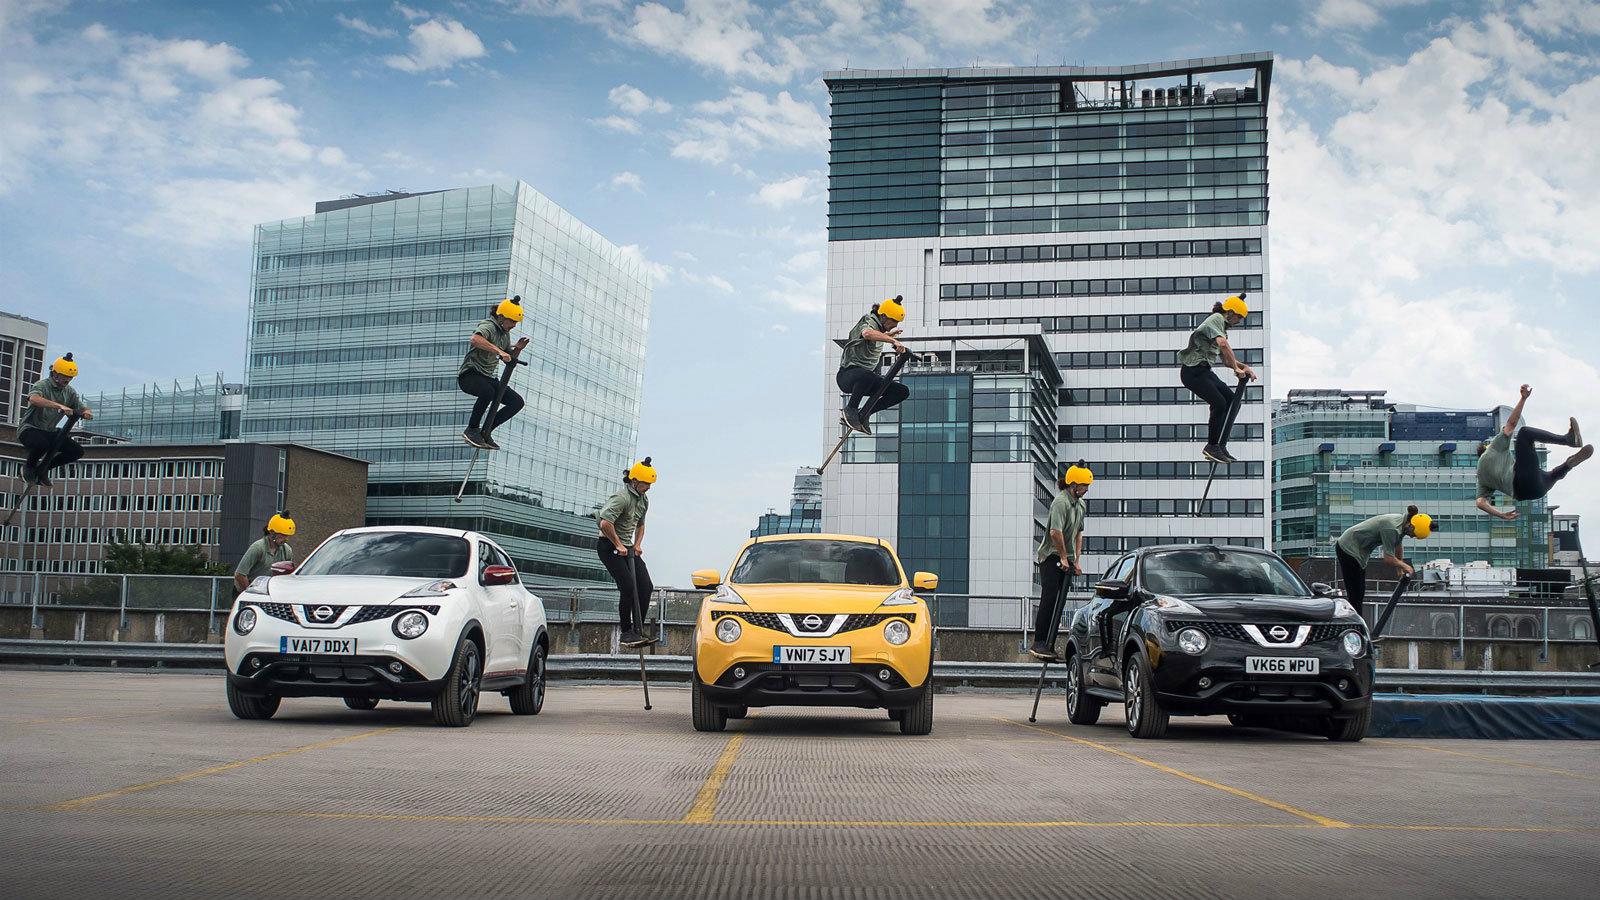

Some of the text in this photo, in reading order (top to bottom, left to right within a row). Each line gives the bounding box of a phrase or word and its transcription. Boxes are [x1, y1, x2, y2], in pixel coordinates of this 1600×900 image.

[292, 639, 350, 653] VA17 DDX
[786, 648, 845, 662] VN17 SJY
[1252, 659, 1314, 672] VK66 WPU
